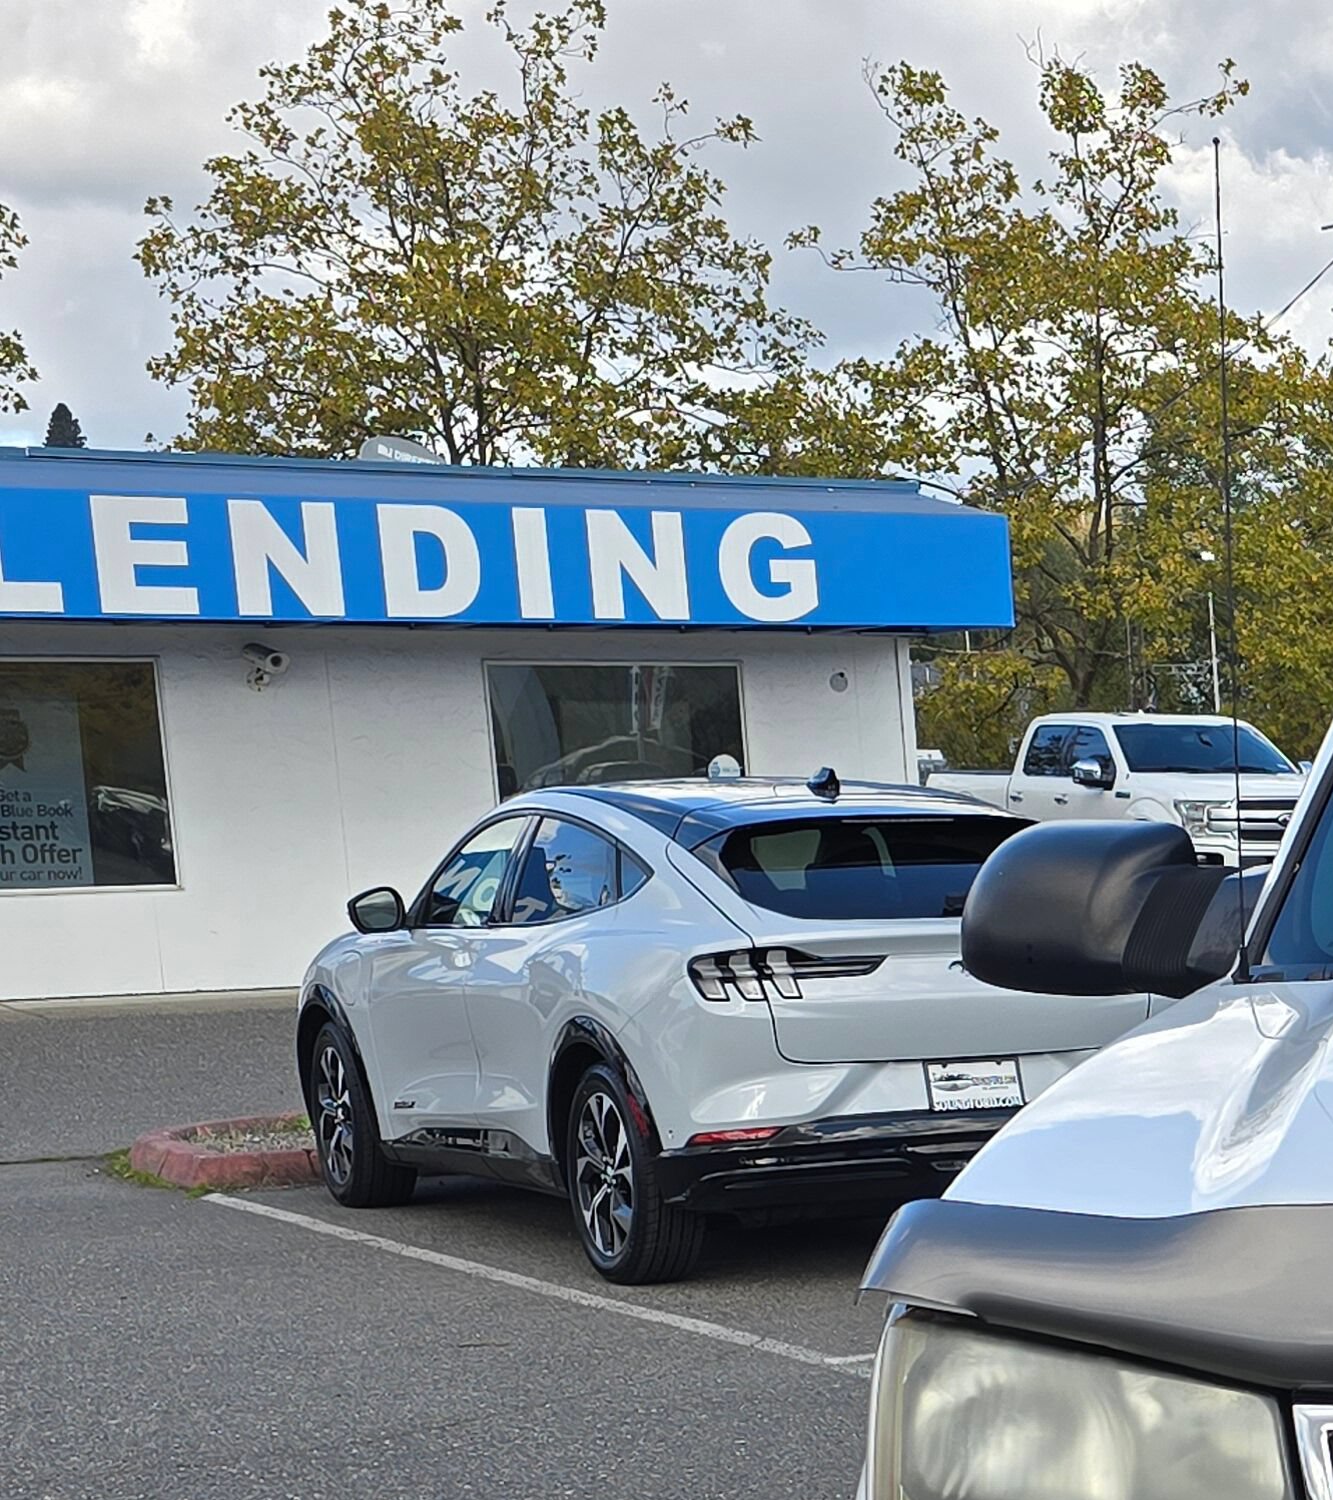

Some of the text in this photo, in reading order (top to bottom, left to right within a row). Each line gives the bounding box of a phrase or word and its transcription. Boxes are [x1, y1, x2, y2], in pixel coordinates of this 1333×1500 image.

[1, 803, 74, 818] Blue Book
[22, 843, 83, 865] Offer
[20, 870, 44, 881] car
[48, 866, 83, 881] now!
